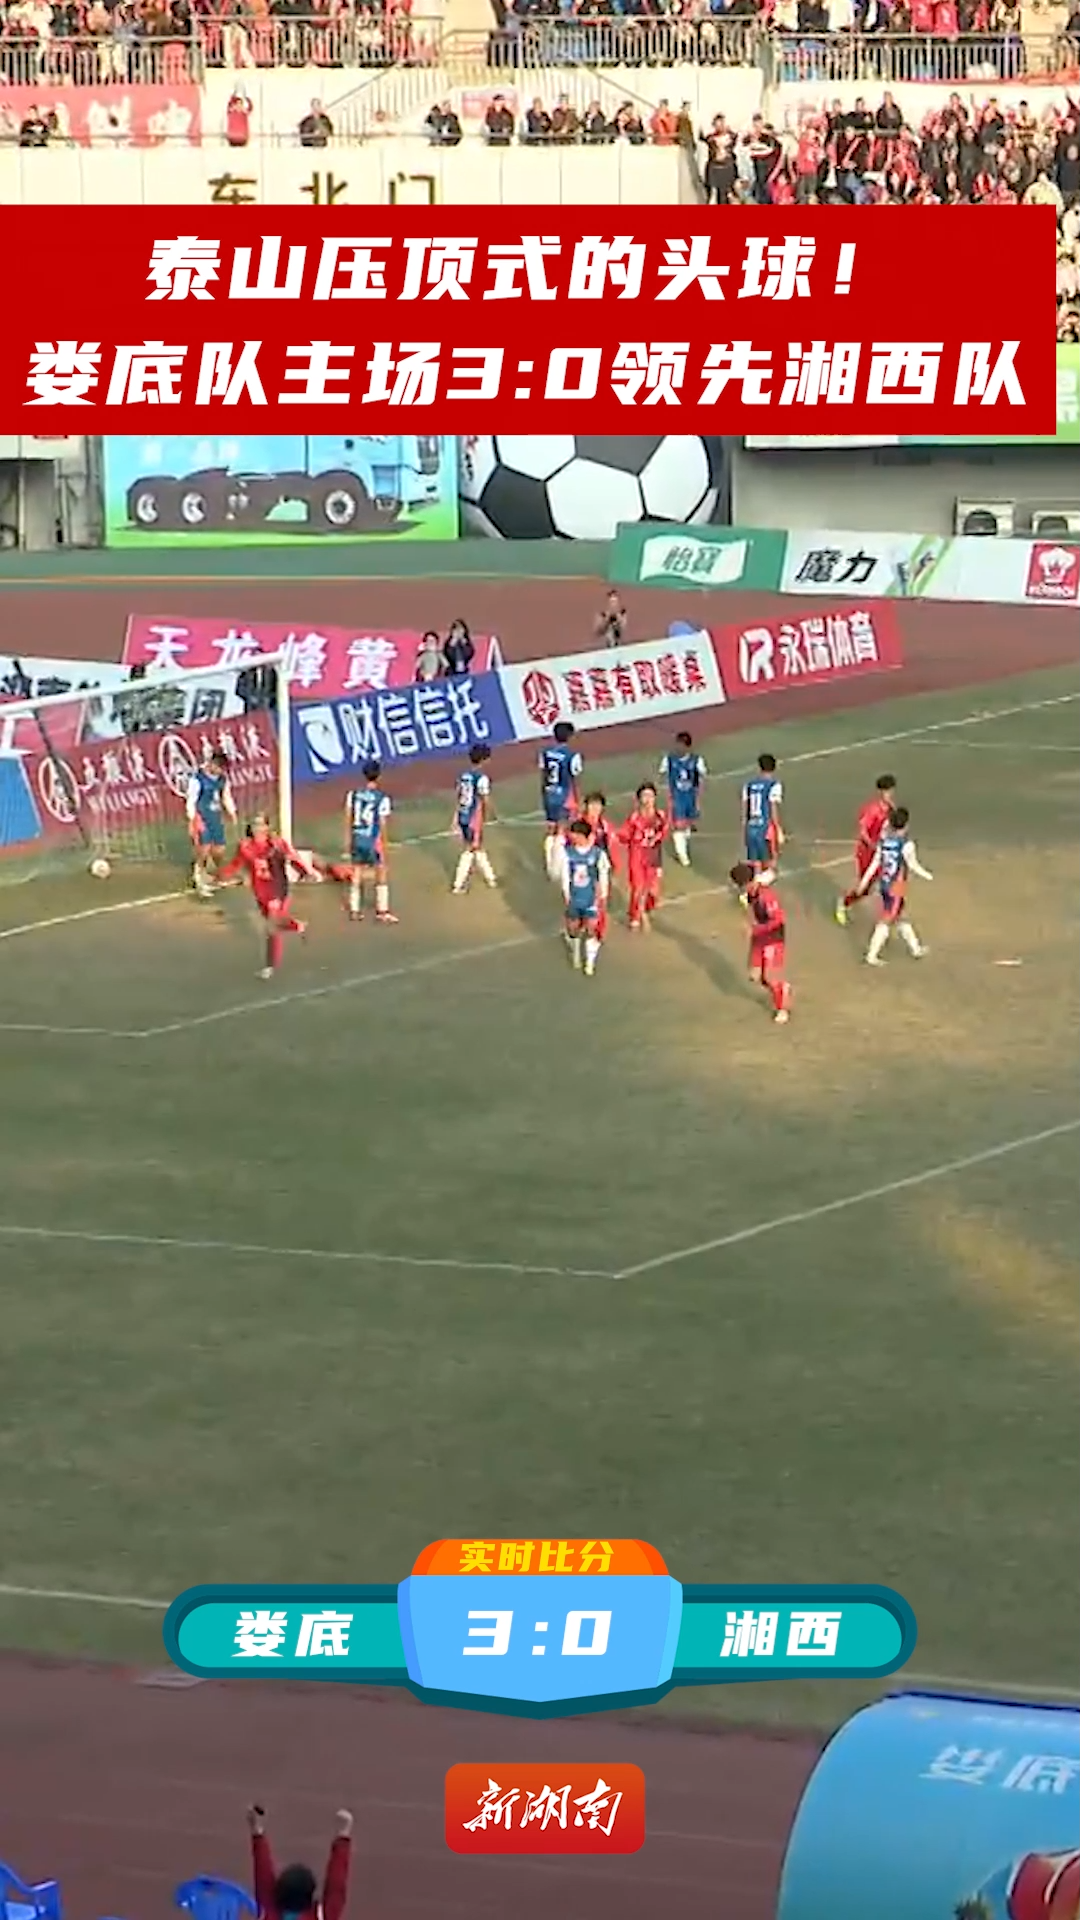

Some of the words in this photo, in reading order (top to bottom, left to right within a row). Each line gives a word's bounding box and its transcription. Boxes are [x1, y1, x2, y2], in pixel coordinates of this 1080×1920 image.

[794, 546, 880, 584] 魔力
[777, 610, 881, 677] 永瑞体育
[339, 679, 489, 766] 财信信托
